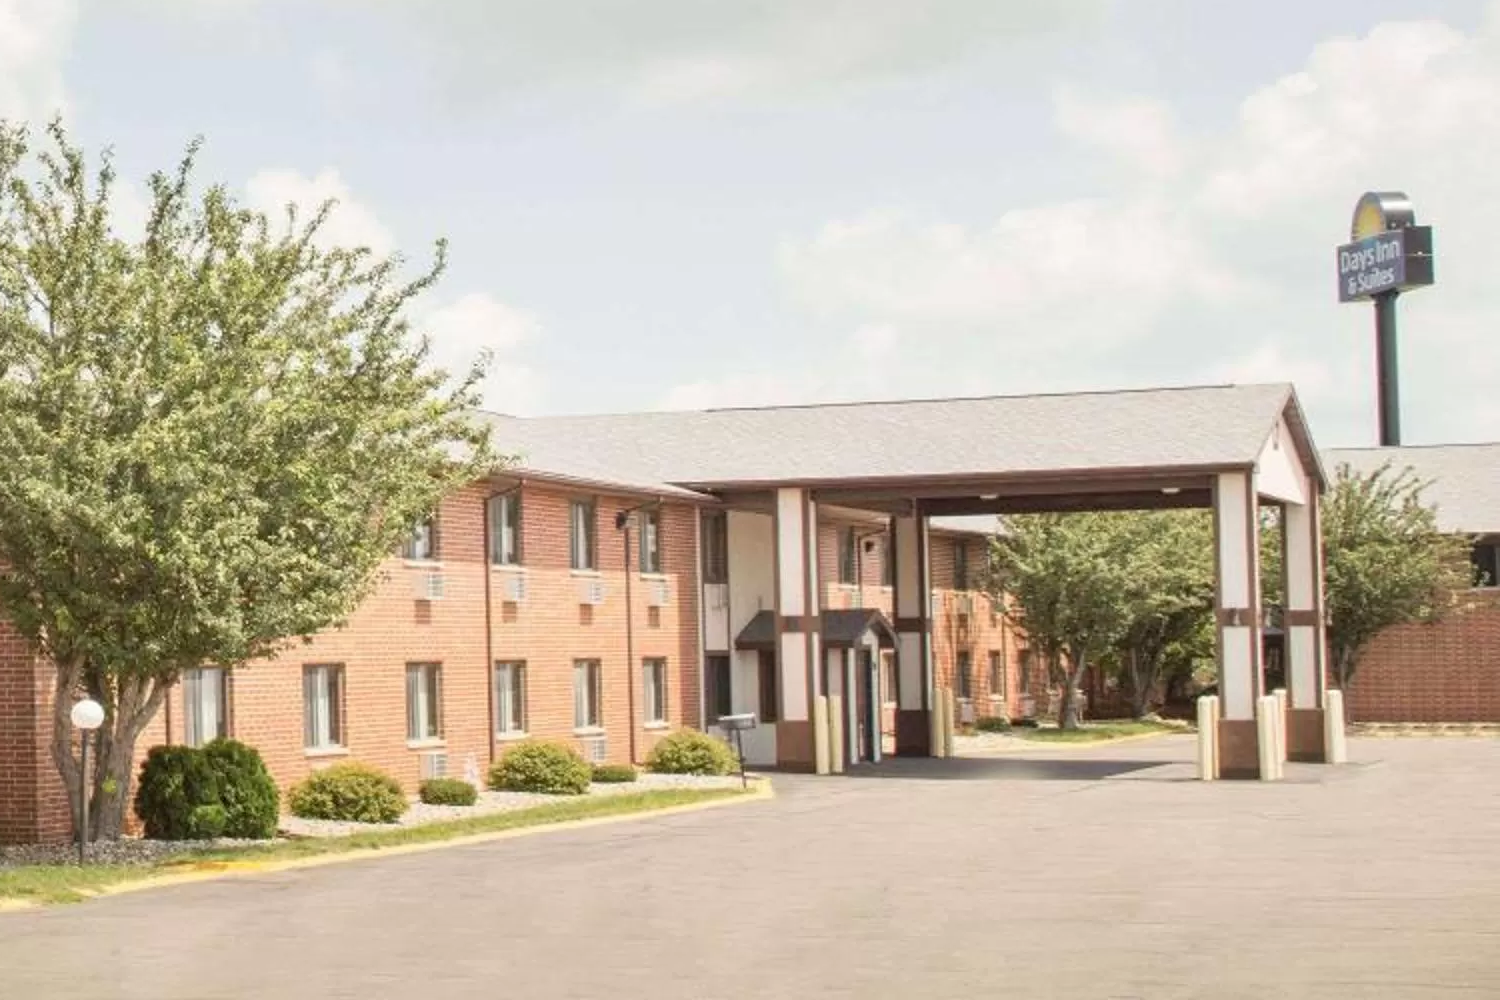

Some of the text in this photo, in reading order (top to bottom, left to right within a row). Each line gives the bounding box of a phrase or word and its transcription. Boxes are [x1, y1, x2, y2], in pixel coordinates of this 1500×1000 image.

[1341, 240, 1400, 274] Days Inn
[1358, 267, 1395, 292] Suites
